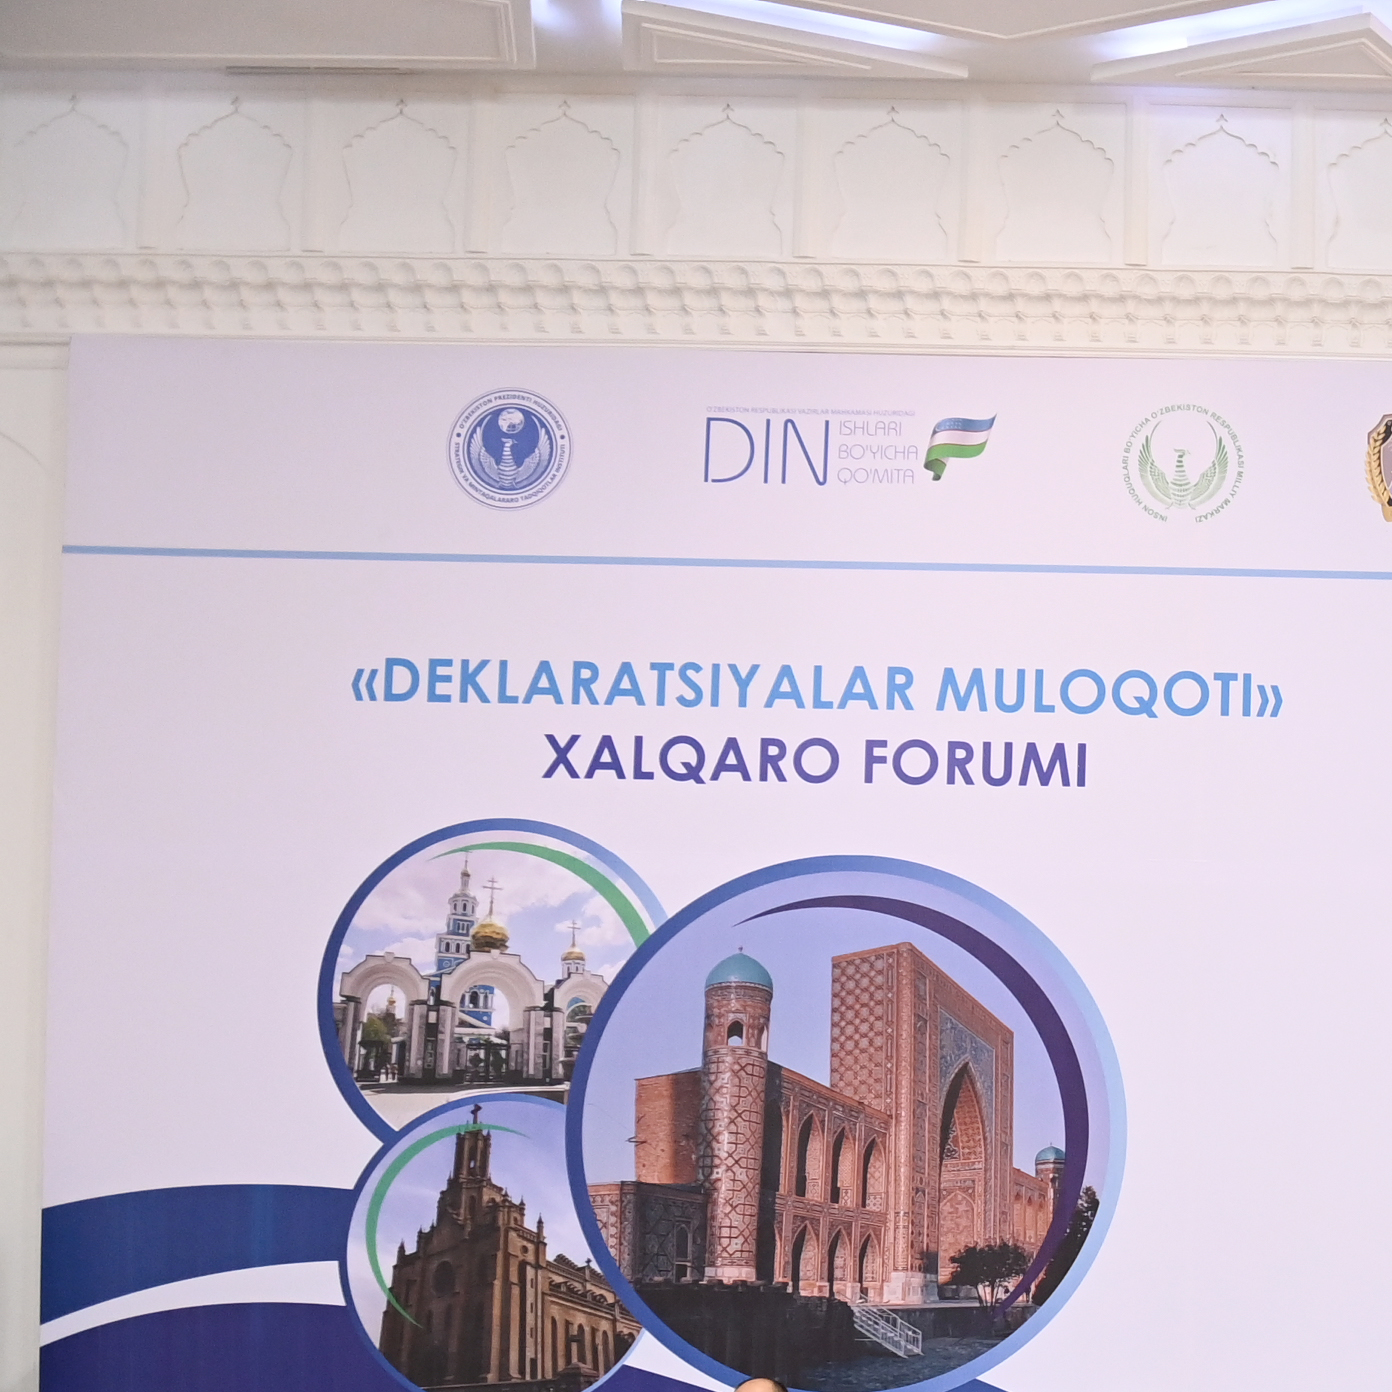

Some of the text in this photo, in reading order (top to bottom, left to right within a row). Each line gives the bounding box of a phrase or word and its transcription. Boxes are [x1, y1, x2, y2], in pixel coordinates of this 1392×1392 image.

[839, 420, 902, 437] ISHLARI
[1210, 412, 1244, 468] RESPUBLIKASI
[704, 417, 829, 486] DIN
[838, 444, 919, 460] BO'YICHA
[836, 468, 914, 485] QO'MITA
[1230, 470, 1243, 498] MILLIY
[1143, 504, 1168, 522] INSON
[1195, 498, 1231, 523] MARKAZI
[351, 657, 1284, 719] «DEKLARATSIYALAR MULOQOTI»
[541, 733, 1087, 787] XALQARO FORUMI
